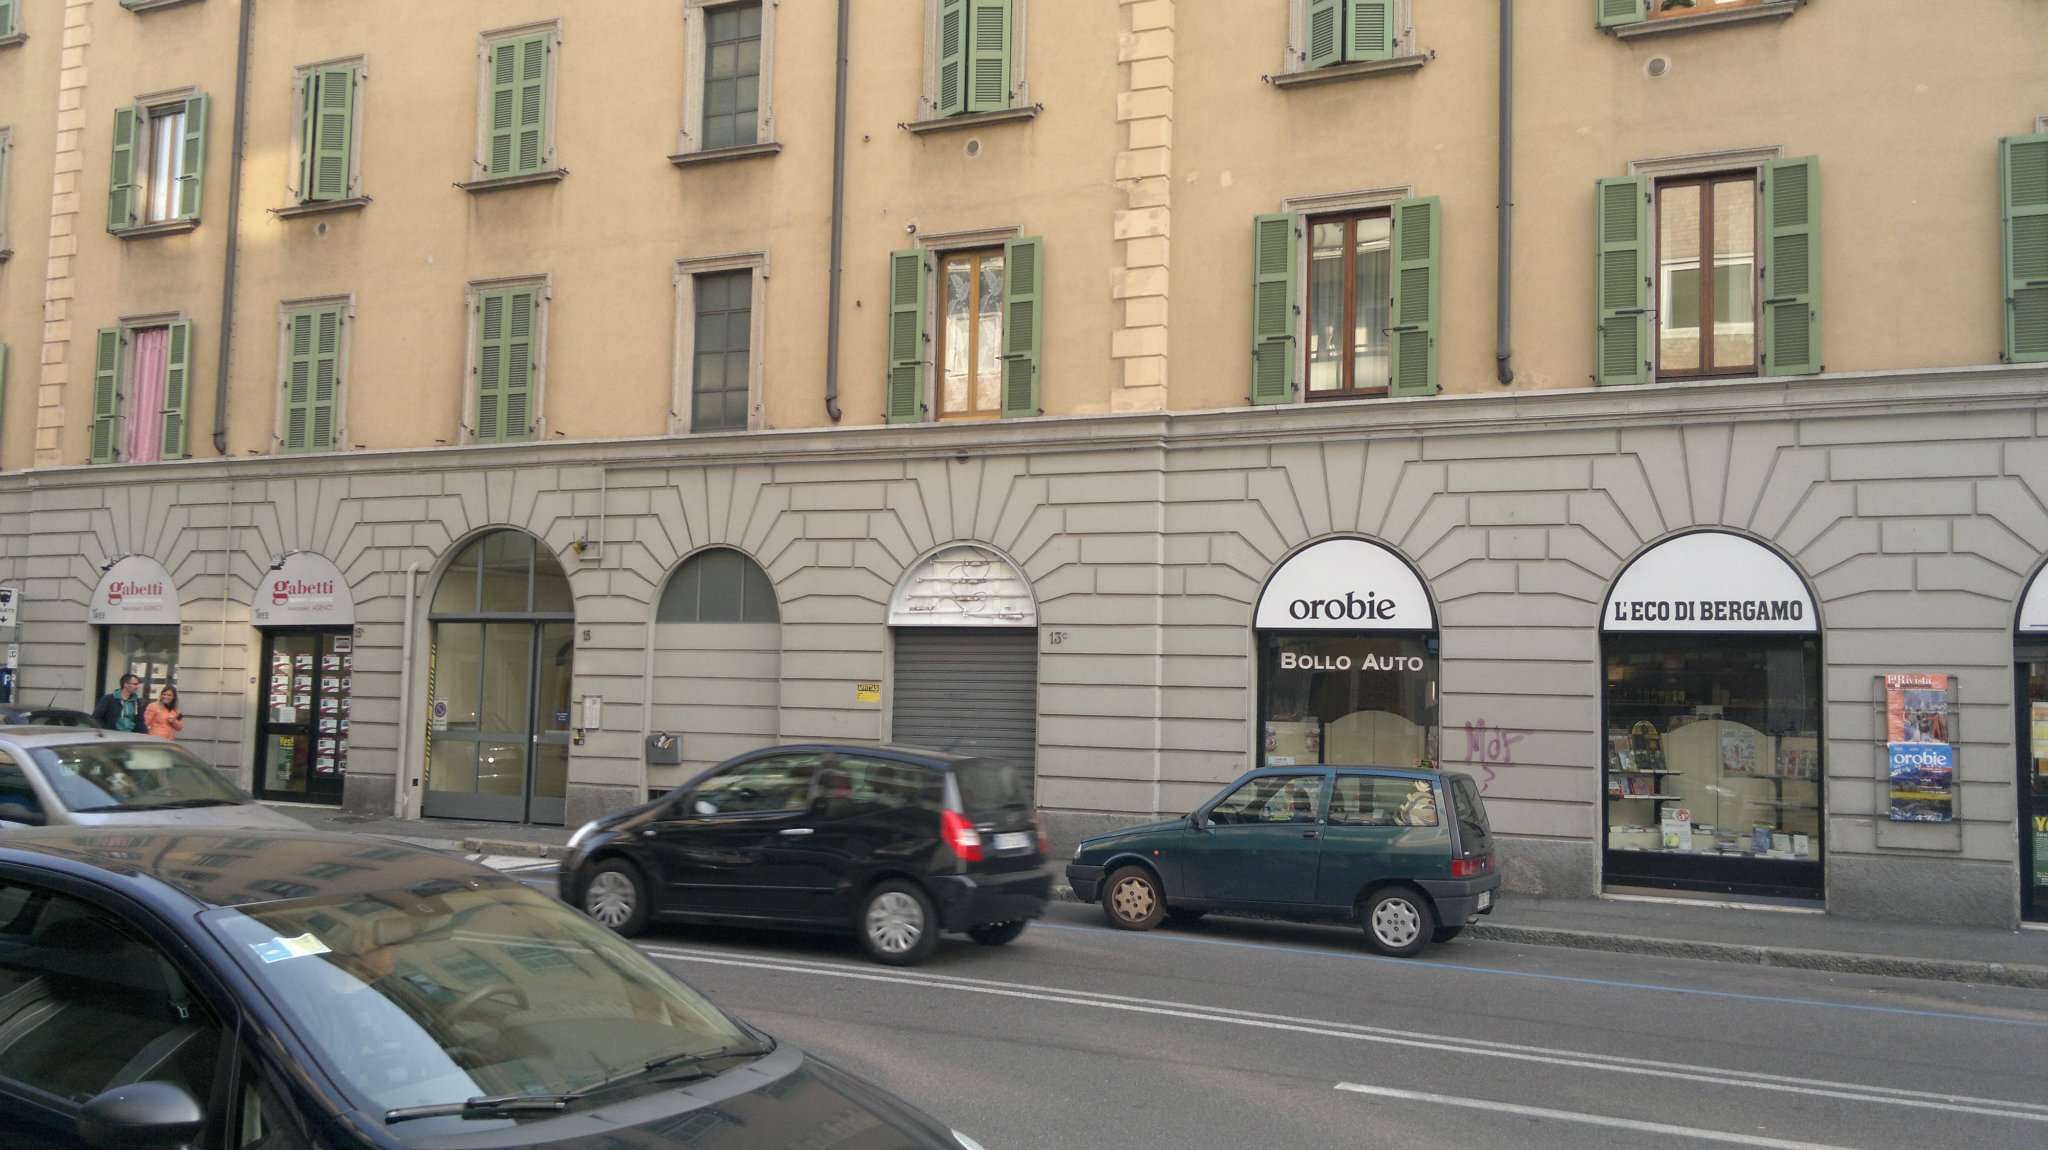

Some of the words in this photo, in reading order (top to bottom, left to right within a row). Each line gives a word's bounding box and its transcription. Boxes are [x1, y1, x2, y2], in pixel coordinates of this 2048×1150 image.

[107, 581, 164, 606] gabetti
[272, 579, 334, 606] gabetti
[1289, 591, 1396, 620] orobie
[1614, 600, 1670, 621] L'ECO
[1674, 600, 1696, 621] DI
[1699, 600, 1803, 621] BERGAMO
[1280, 652, 1352, 670] BOLLO
[1361, 653, 1424, 672] AUTO
[1894, 751, 1947, 766] orobie
